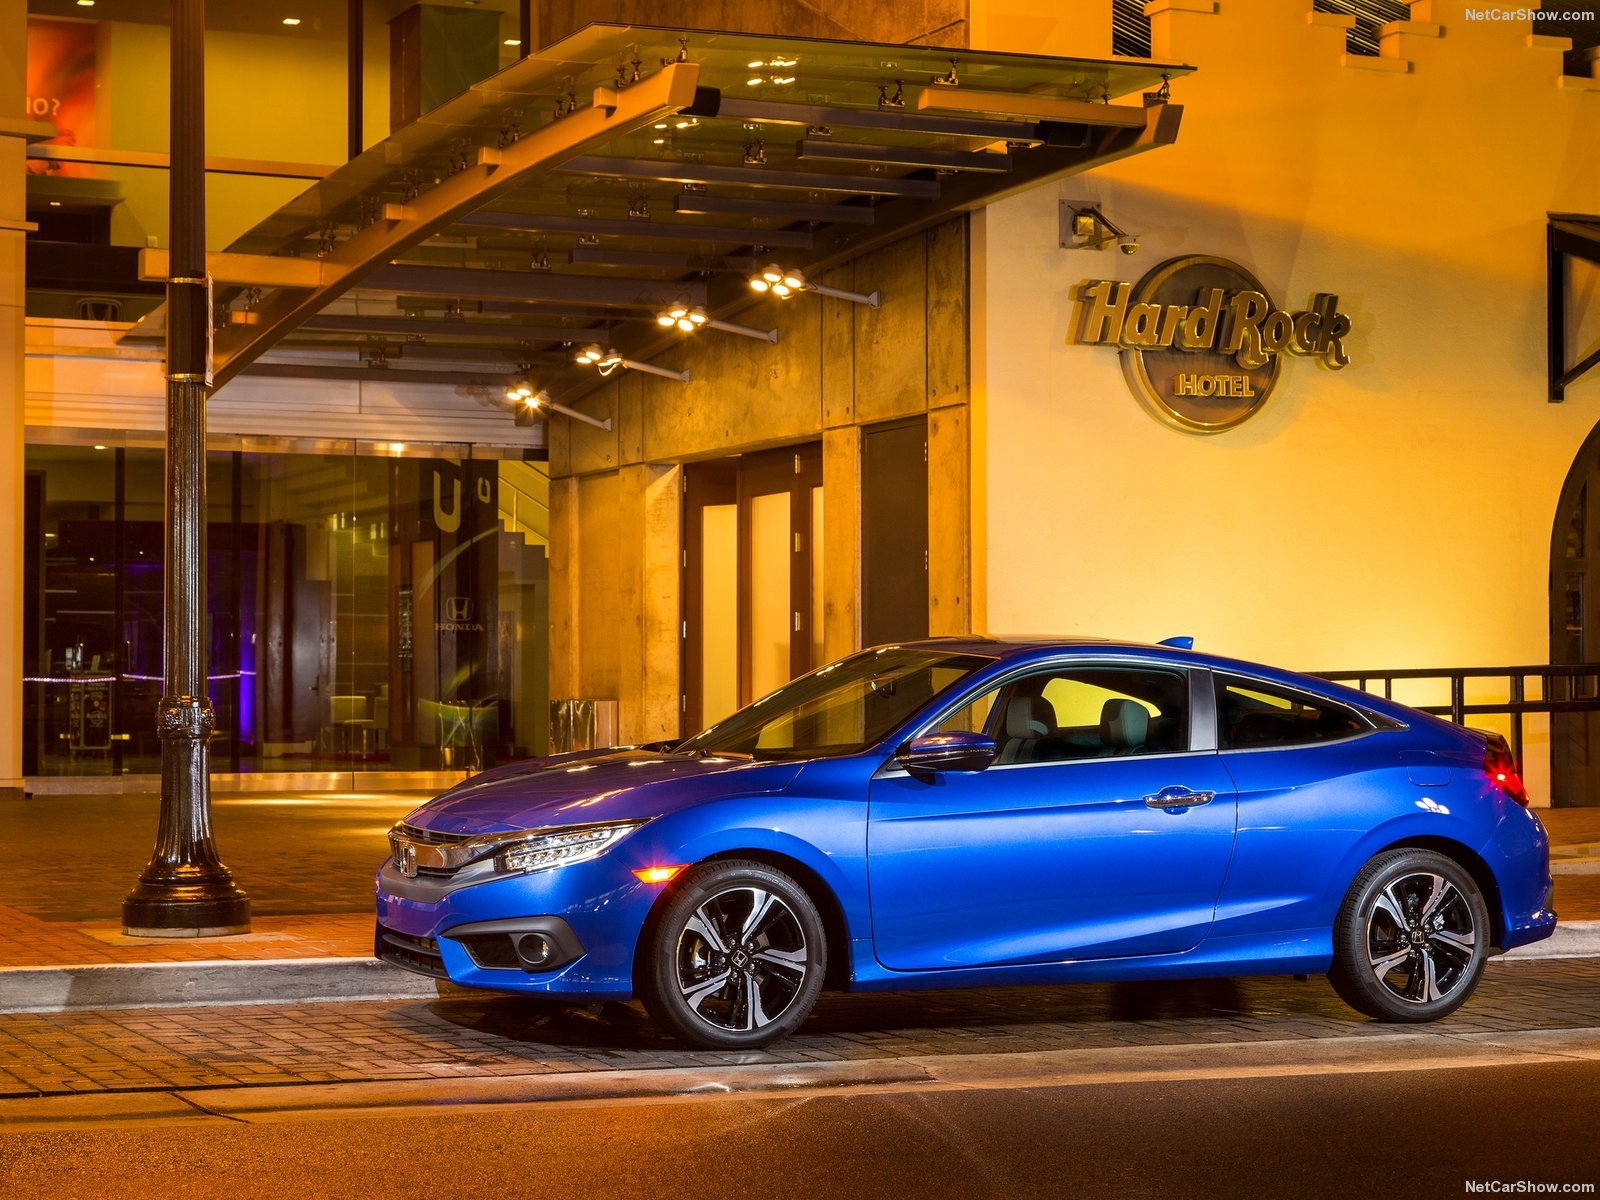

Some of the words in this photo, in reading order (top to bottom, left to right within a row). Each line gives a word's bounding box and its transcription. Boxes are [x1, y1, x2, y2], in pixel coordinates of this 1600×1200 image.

[1080, 280, 1225, 352] Hard
[1229, 289, 1352, 367] Rock
[1176, 373, 1255, 398] HOTEL
[434, 623, 485, 632] HONDA
